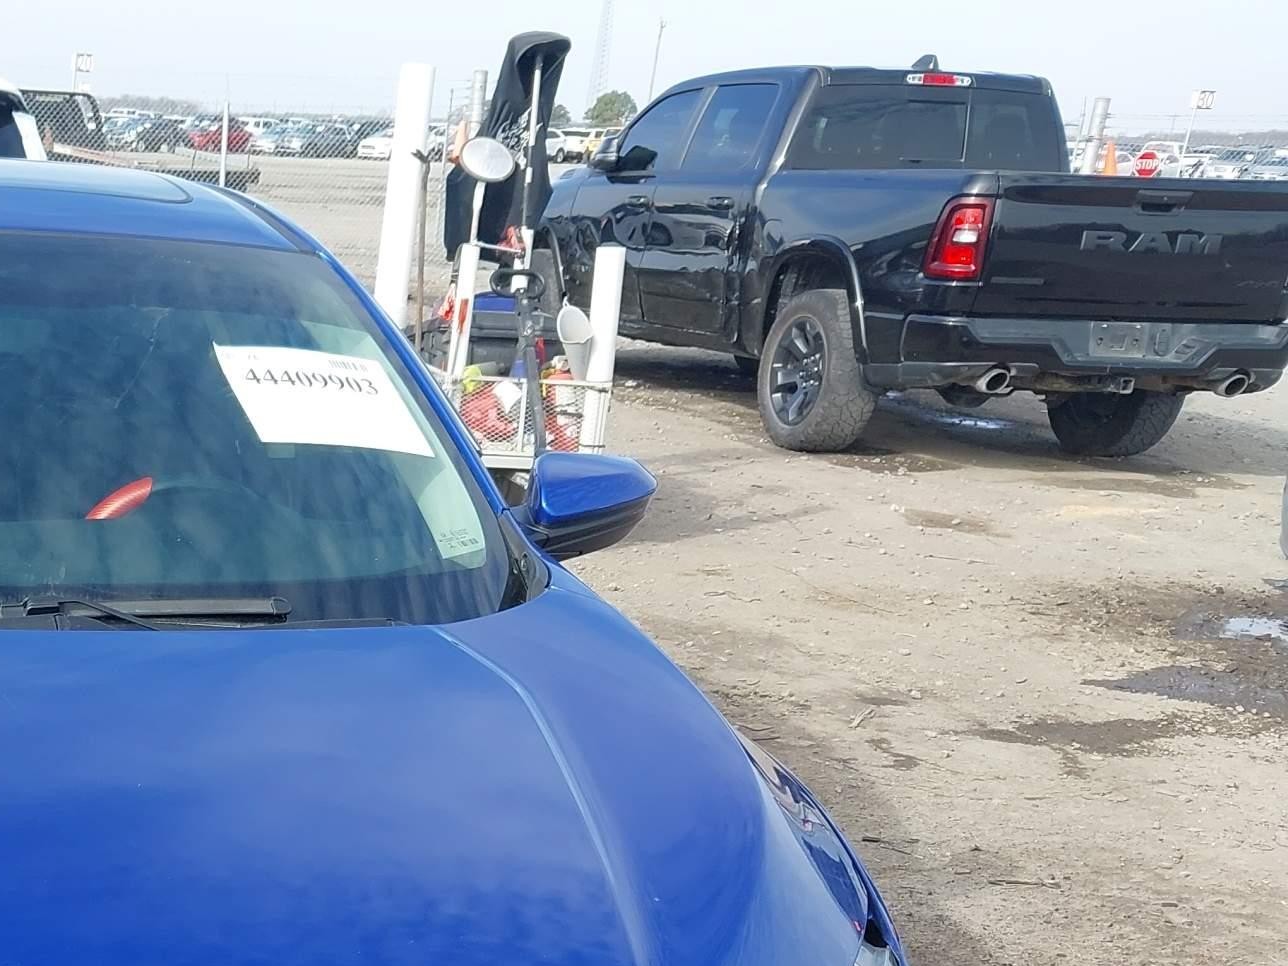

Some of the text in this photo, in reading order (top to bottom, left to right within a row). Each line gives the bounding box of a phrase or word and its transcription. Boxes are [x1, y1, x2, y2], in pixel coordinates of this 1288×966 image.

[1135, 158, 1159, 171] STOP
[1079, 230, 1224, 255] RAM
[245, 367, 379, 396] 44409903
